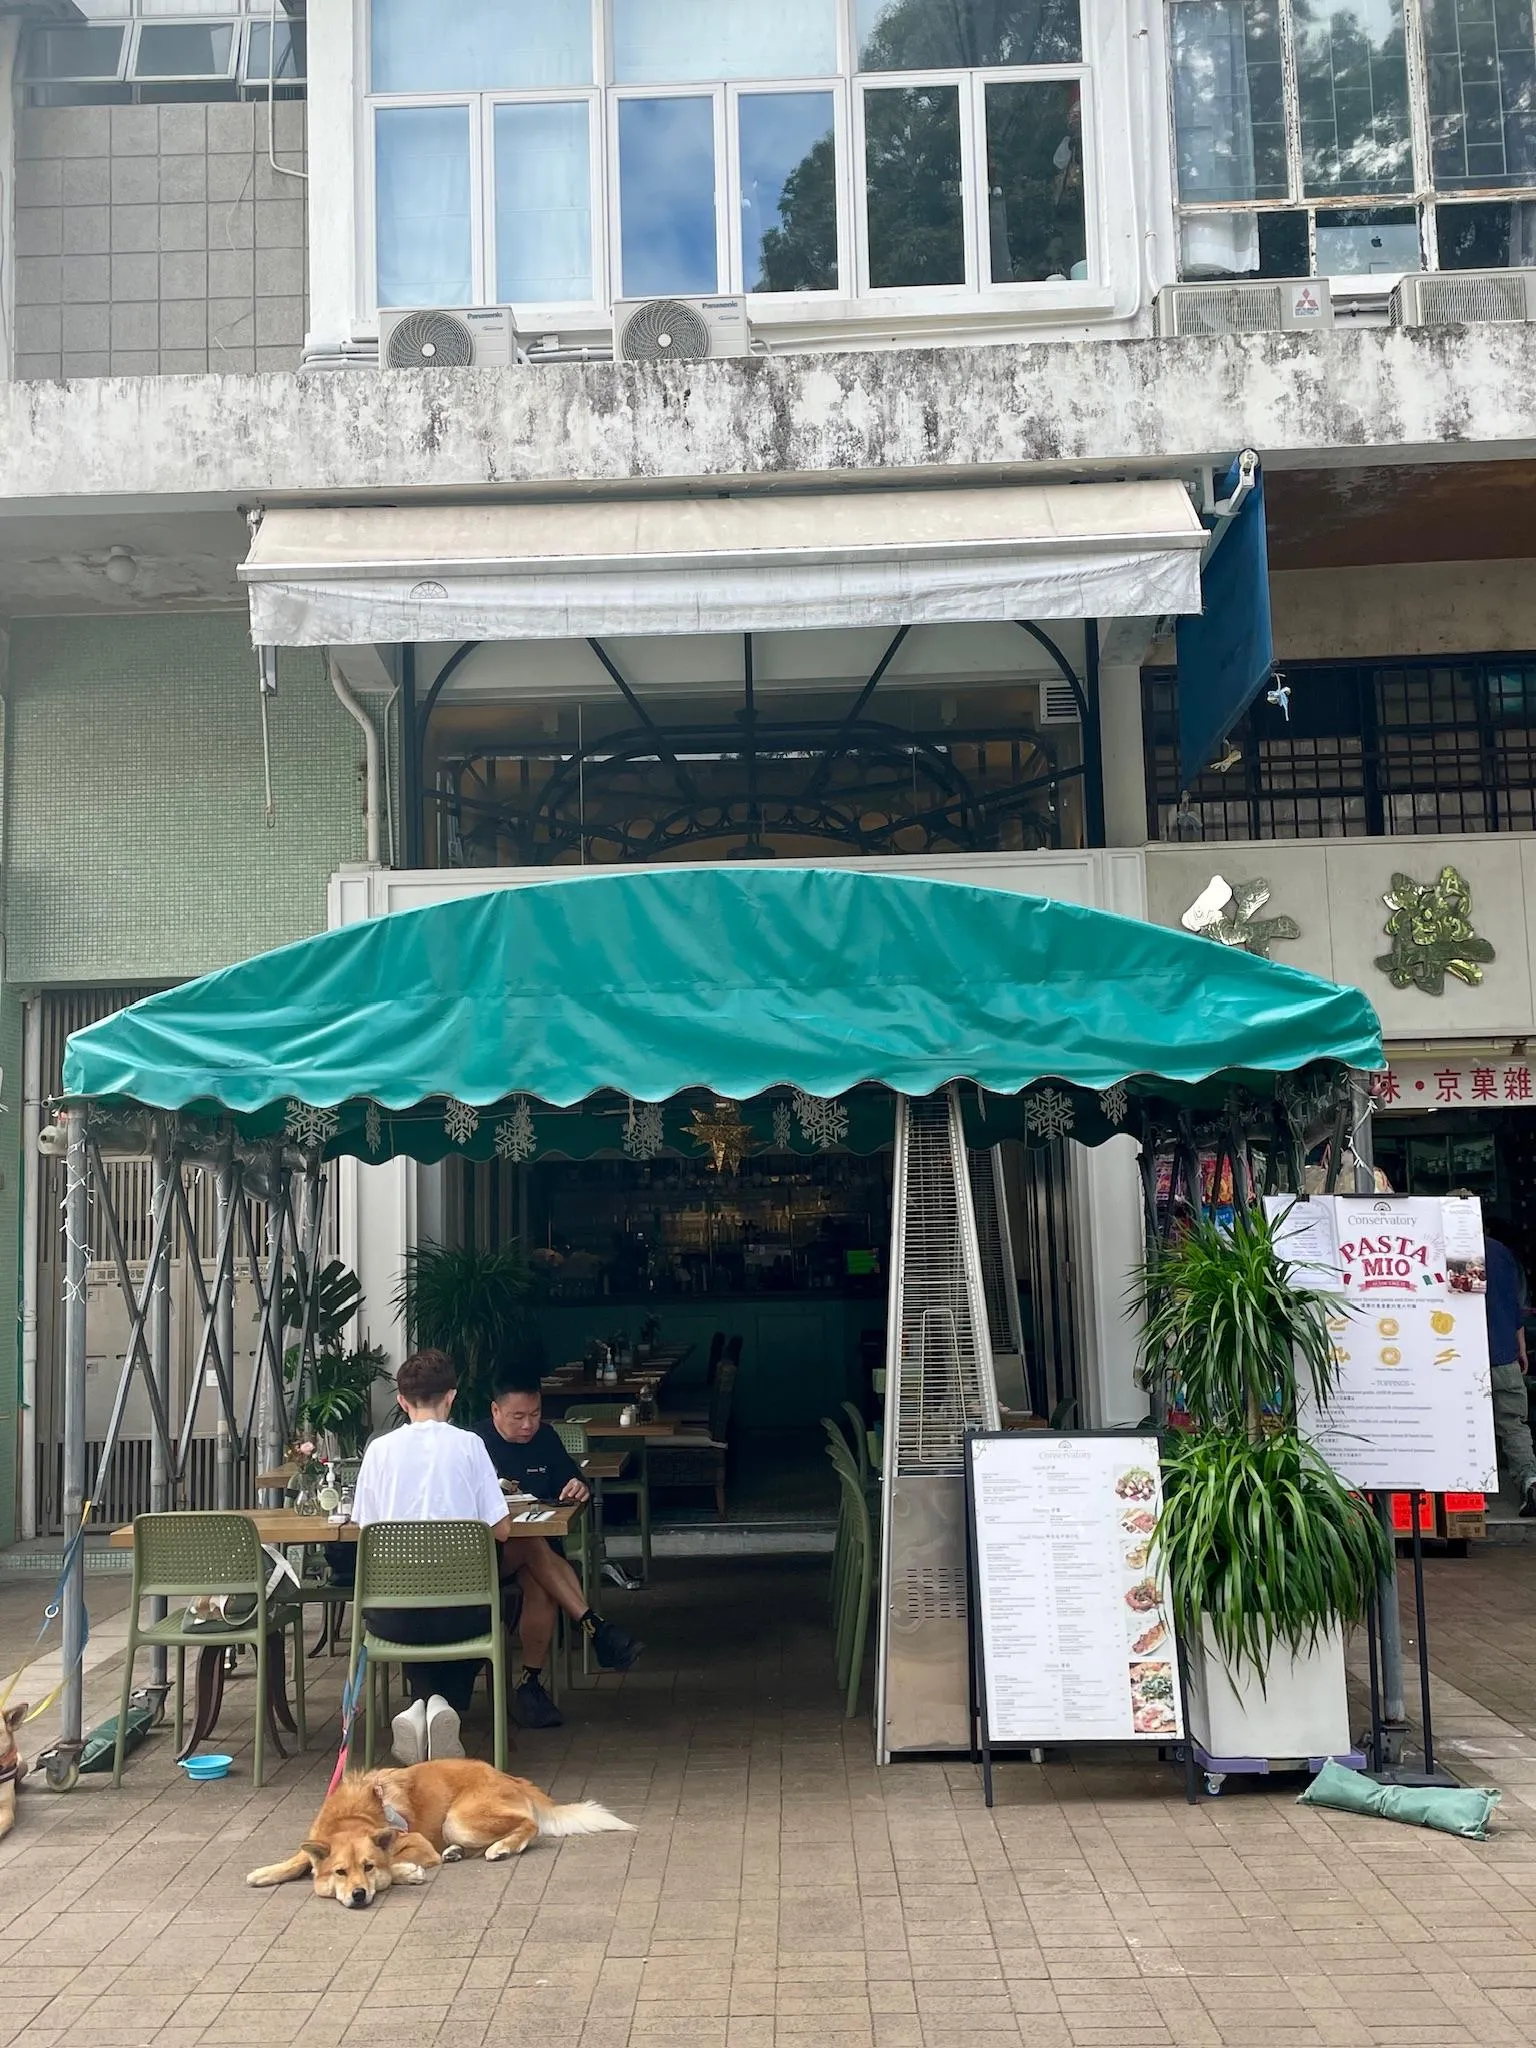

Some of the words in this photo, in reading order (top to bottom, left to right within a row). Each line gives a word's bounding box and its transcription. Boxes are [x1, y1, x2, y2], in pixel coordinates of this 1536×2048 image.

[702, 301, 738, 309] Panasonic
[467, 312, 503, 320] Panasonic
[1347, 1215, 1418, 1227] Conservatory
[1339, 1235, 1428, 1267] PASTA
[1361, 1258, 1411, 1277] MIO
